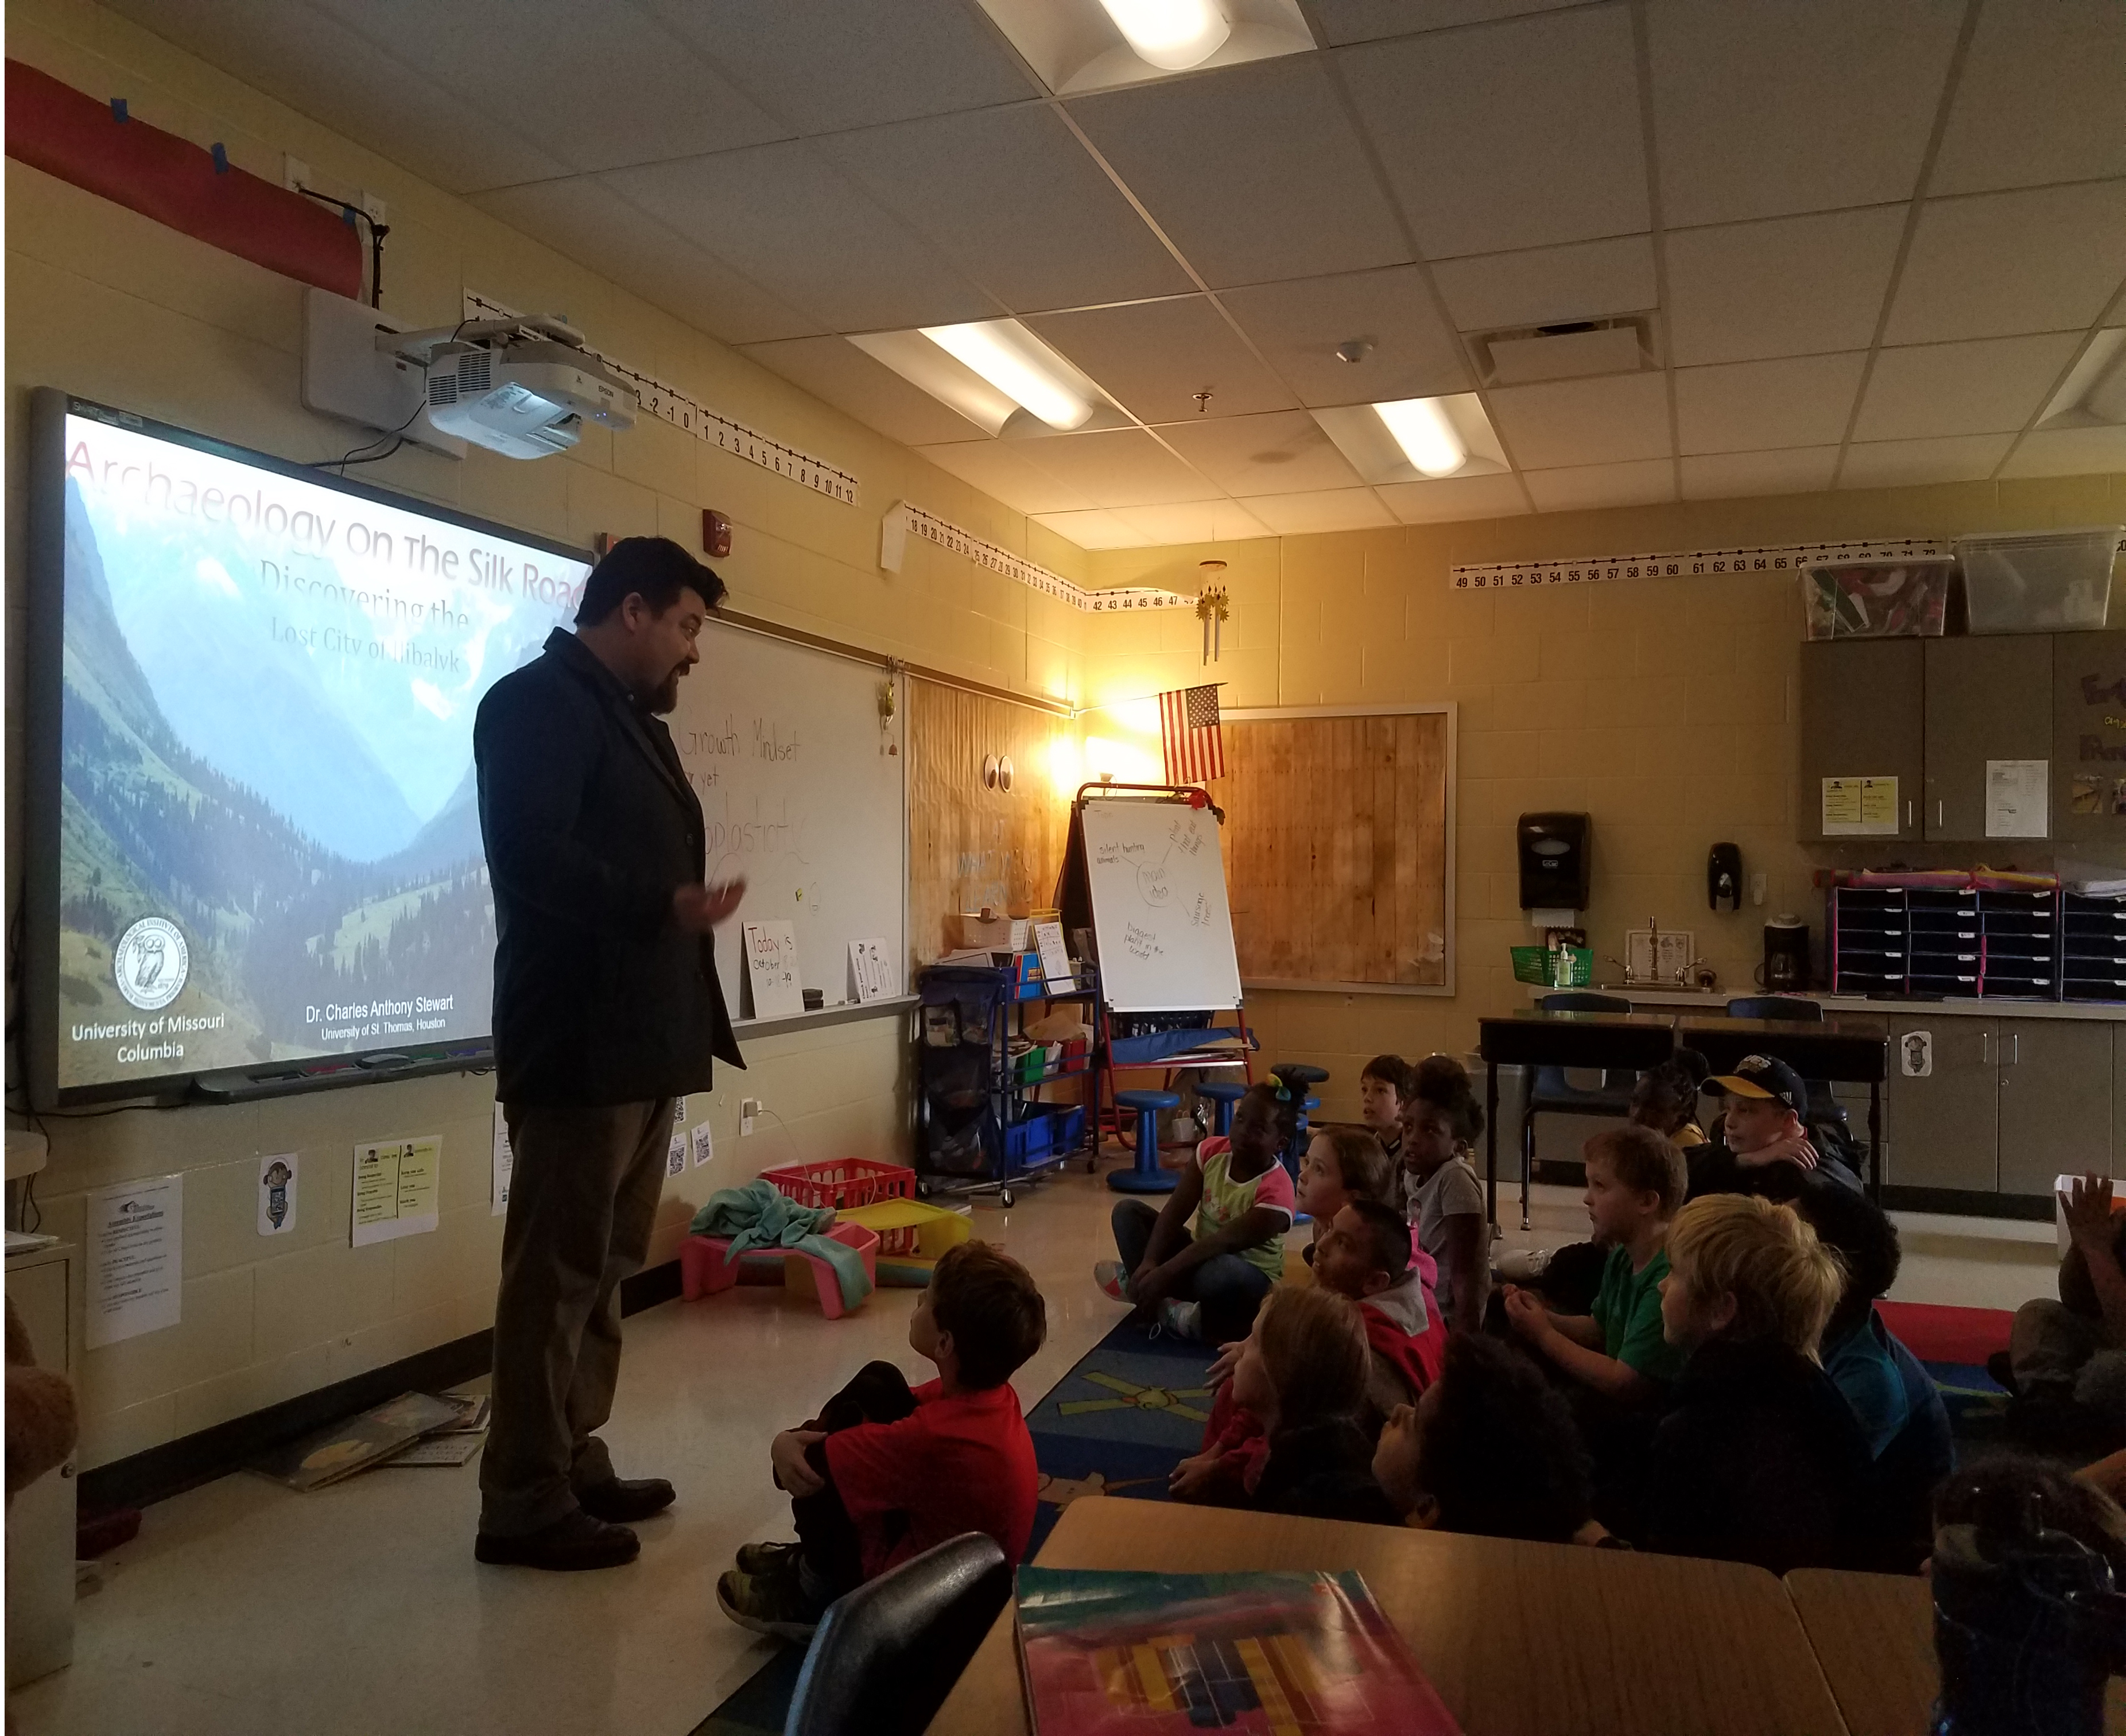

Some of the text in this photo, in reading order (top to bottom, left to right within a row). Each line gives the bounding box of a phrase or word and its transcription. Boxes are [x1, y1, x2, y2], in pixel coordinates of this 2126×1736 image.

[599, 385, 614, 398] EPSON
[650, 398, 658, 413] -2
[667, 406, 674, 421] -1
[684, 412, 689, 428] 0
[704, 425, 853, 503] 1 2 3 4 5 6 7 8 9 10 11 12
[66, 441, 336, 559] Archaeology
[347, 522, 393, 565] On
[404, 534, 459, 580] The
[468, 548, 513, 595] Silk
[911, 519, 969, 555] 18 19 20 21 22 23 24
[982, 553, 988, 565] 26
[991, 557, 997, 568] 27
[1005, 564, 1010, 575] 29
[1013, 567, 1018, 578] 30
[1021, 570, 1025, 581] 31
[1033, 576, 1037, 587] 33
[1039, 579, 1043, 590] 34
[1046, 582, 1050, 593] 35
[1052, 585, 1057, 595] 36
[1457, 564, 1678, 588] 49 50 51 52 53 54 55 56 57 58 59 60
[1693, 563, 1704, 574] 61
[1713, 561, 1725, 572] 62
[1734, 560, 1745, 571] 63
[1754, 559, 1766, 569] 64
[1775, 558, 1787, 569] 65
[261, 560, 468, 629] Discovering the
[1093, 601, 1102, 610] 42
[1108, 600, 1117, 610] 43
[1123, 599, 1132, 608] 44
[1138, 598, 1147, 607] 45
[1153, 597, 1162, 606] 46
[1169, 596, 1178, 605] 47
[272, 617, 317, 647] Lost
[680, 714, 800, 761] Growth Mindset
[701, 766, 719, 795] yet
[1097, 855, 1119, 864] animals
[1099, 842, 1119, 854] silent
[748, 926, 793, 961] Today is
[1124, 934, 1142, 947] plant
[1128, 921, 1156, 940] biggest
[306, 994, 453, 1024] Dr. Charles Anthony Stewart
[72, 1013, 224, 1042] University of Missouri
[321, 1026, 359, 1041] University
[362, 1025, 369, 1037] of
[383, 1021, 414, 1034] Thomas,
[416, 1017, 446, 1030] Houston
[117, 1044, 184, 1063] Columbia
